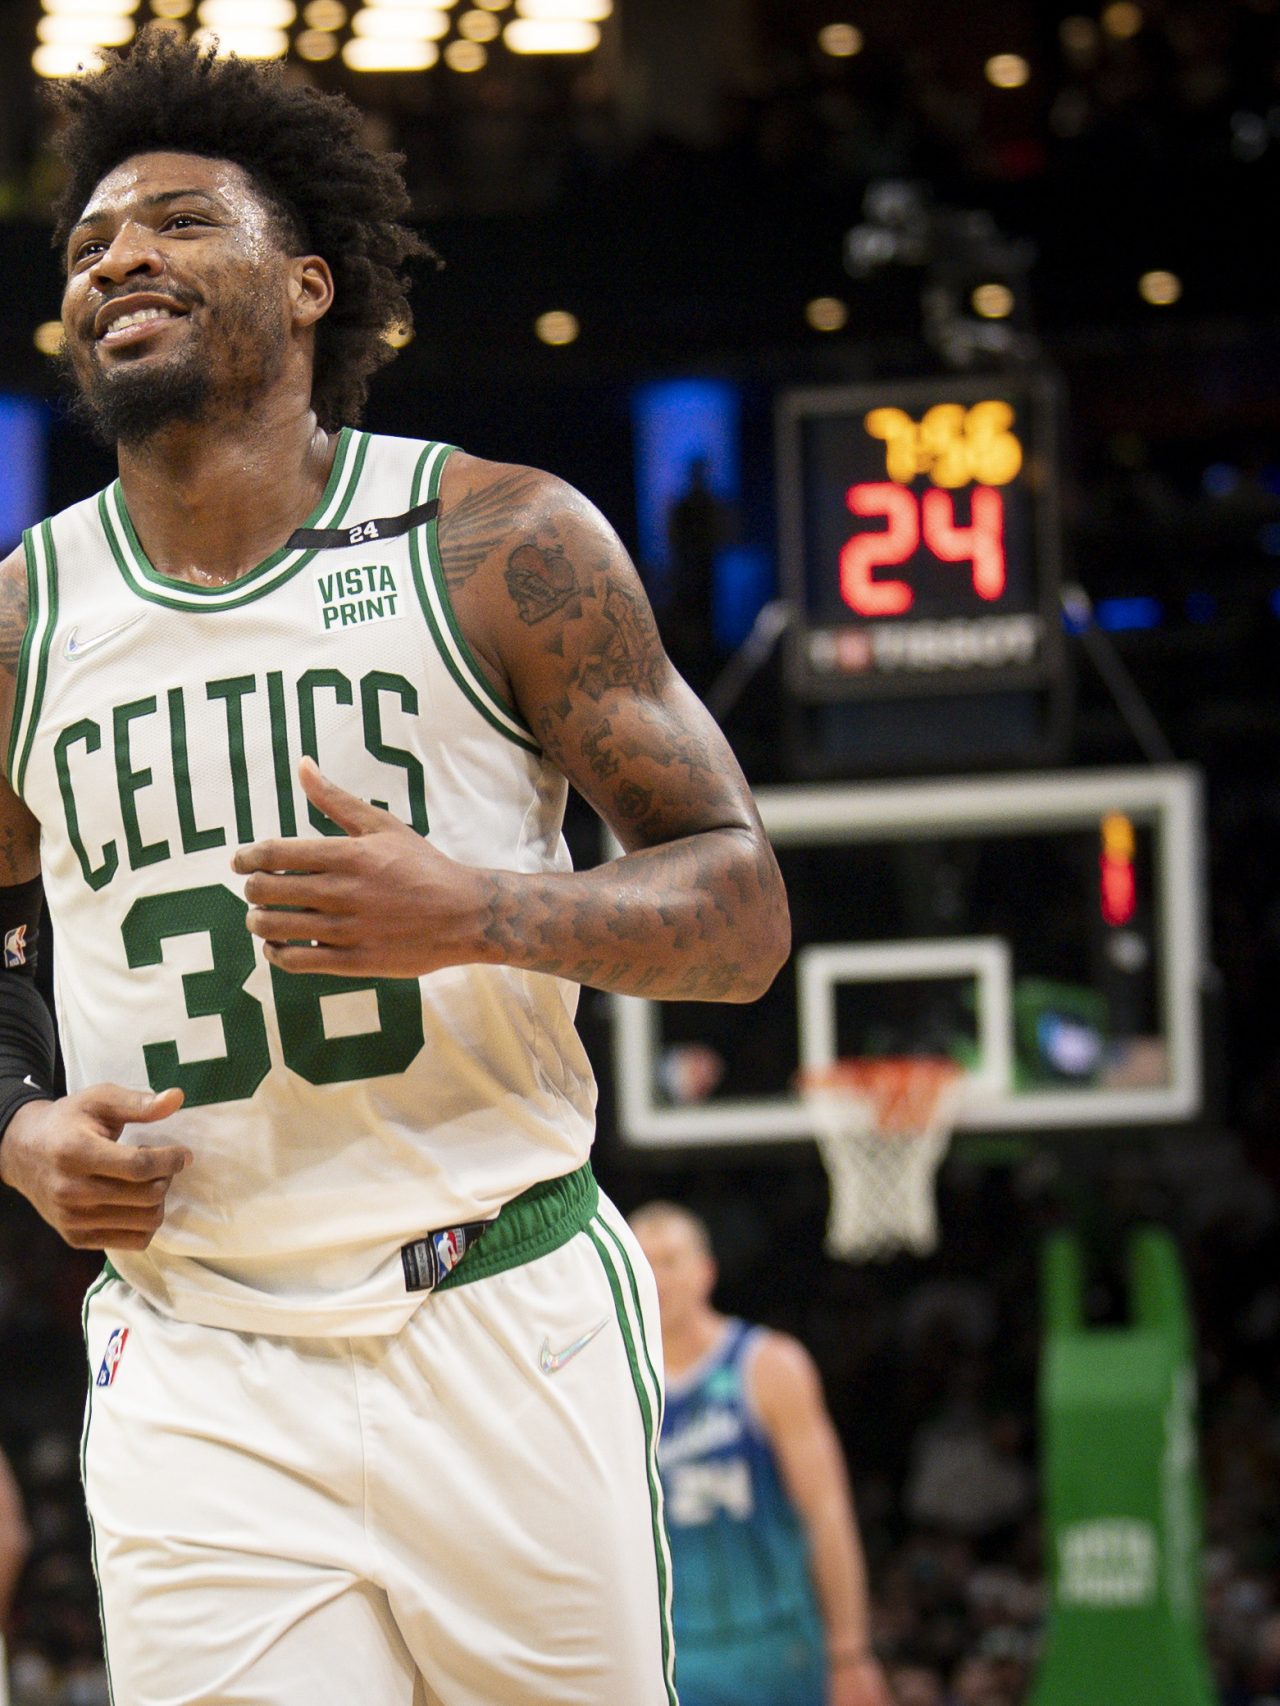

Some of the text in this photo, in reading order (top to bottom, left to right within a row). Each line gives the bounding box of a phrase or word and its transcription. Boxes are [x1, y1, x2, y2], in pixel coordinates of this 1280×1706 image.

[349, 521, 380, 544] 24
[838, 481, 1006, 617] 24
[317, 565, 397, 604] VISTA
[321, 594, 398, 629] PRINT
[53, 669, 430, 892] CELTICS
